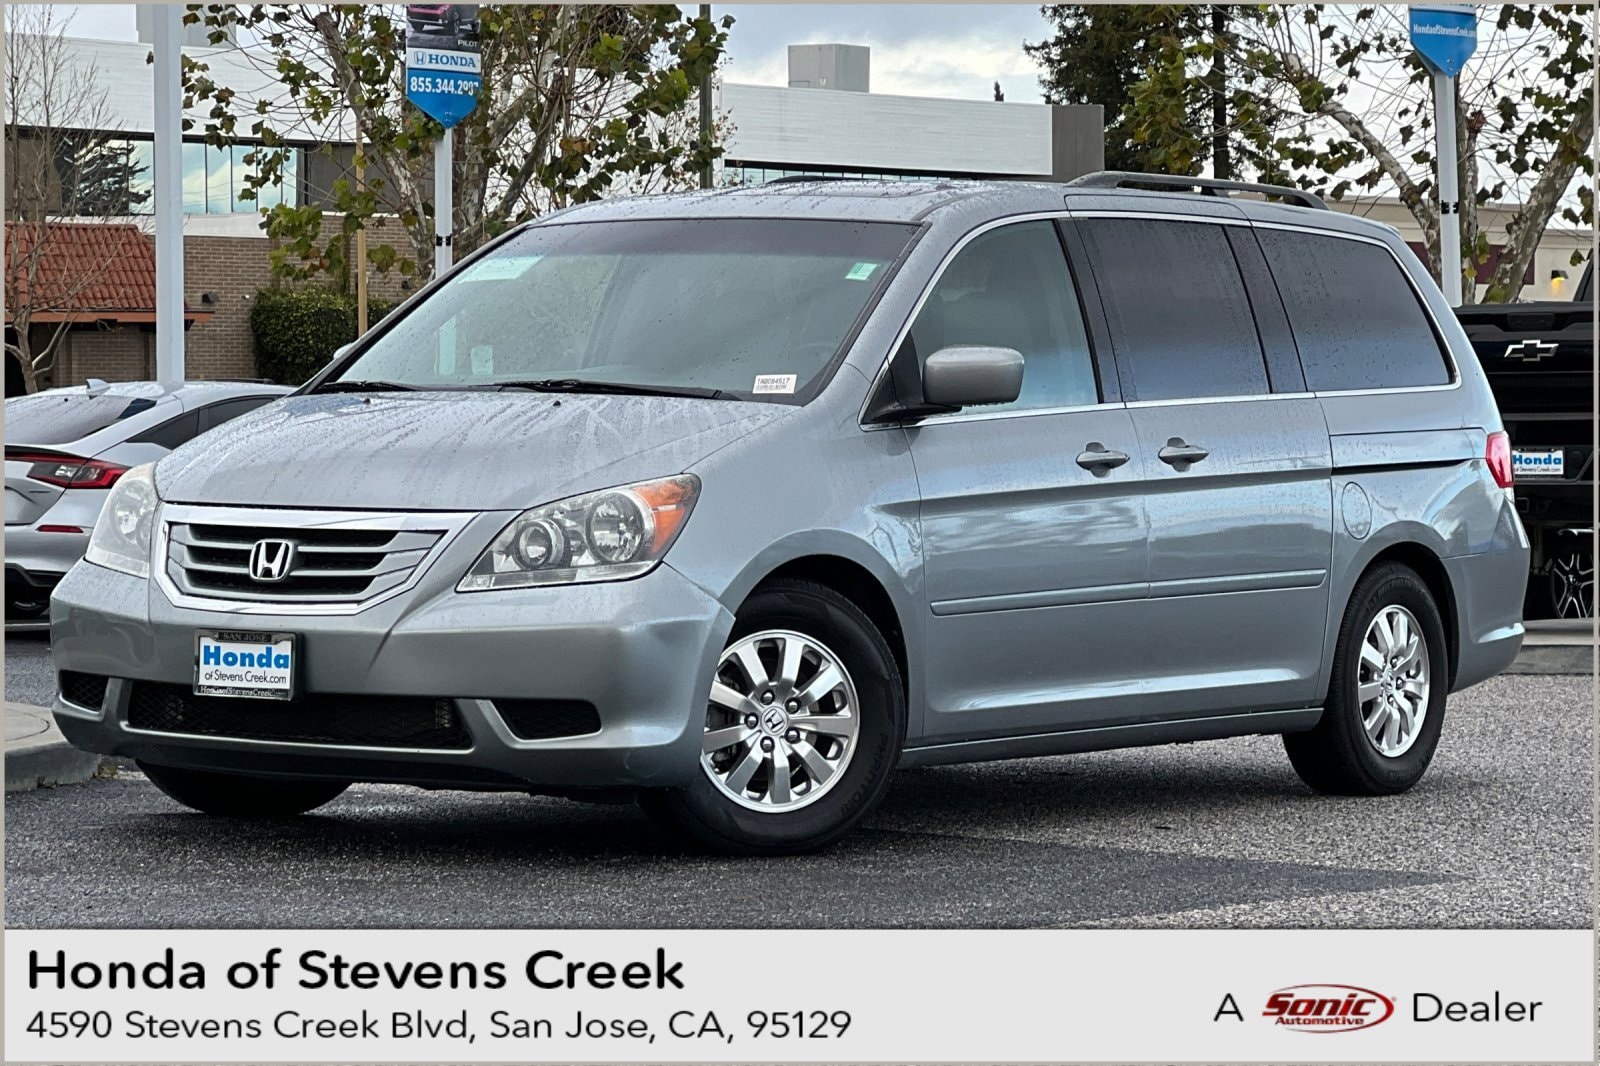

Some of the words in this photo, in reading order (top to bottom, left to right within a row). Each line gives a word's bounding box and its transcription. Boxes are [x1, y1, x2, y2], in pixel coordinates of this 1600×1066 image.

[457, 39, 478, 47] PILOT
[428, 53, 477, 68] HONDA
[1512, 454, 1562, 465] Honda
[203, 645, 290, 669] Honda
[204, 671, 214, 681] of
[214, 669, 243, 681] Stevens
[244, 670, 287, 684] Creek.com
